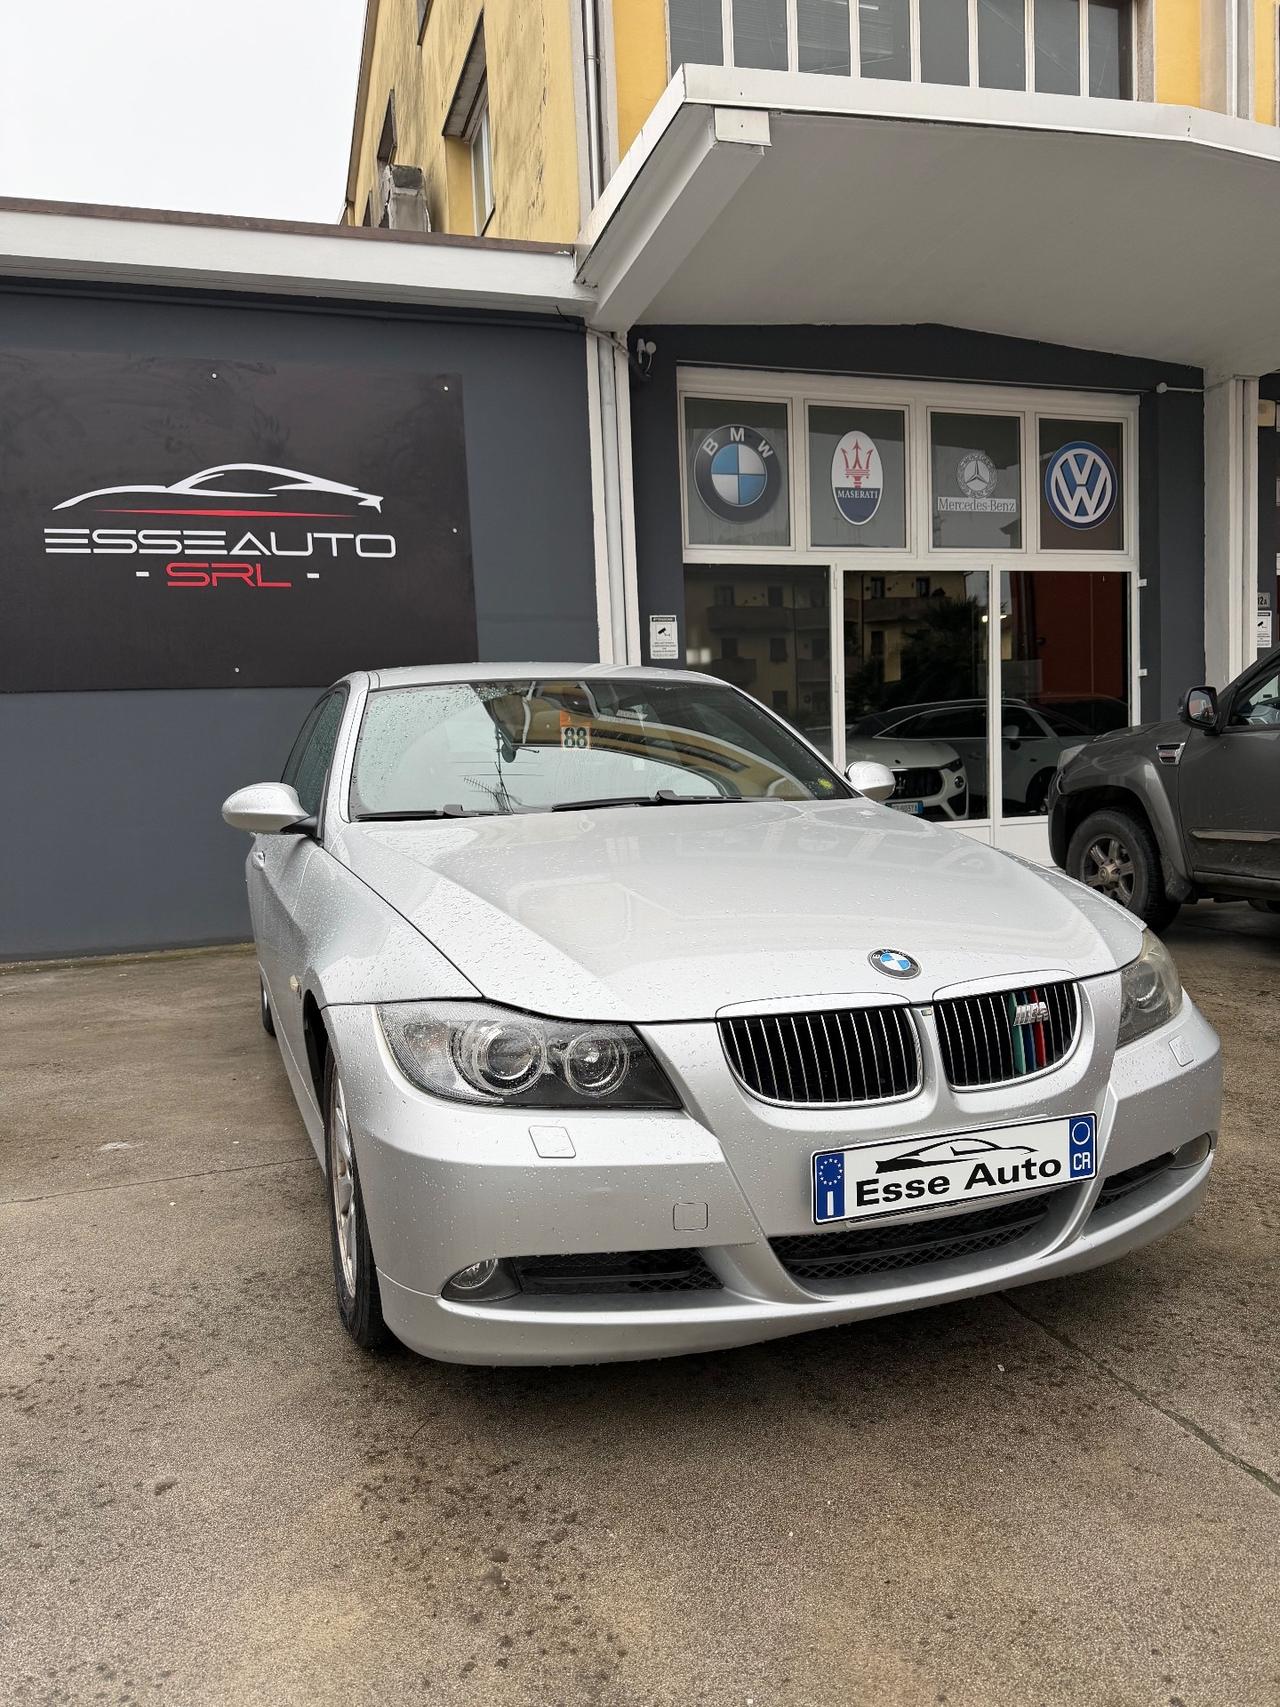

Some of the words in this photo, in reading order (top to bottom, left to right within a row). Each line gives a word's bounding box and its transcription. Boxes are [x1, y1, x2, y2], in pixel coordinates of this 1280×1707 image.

[702, 427, 774, 459] BMW
[837, 489, 879, 500] MASERATI
[938, 498, 1016, 512] Mercedes-Benz
[44, 528, 396, 558] ESSEAUTO
[166, 562, 292, 587] SRL
[564, 727, 587, 748] 88
[856, 1175, 950, 1207] Esse
[964, 1157, 1062, 1190] Auto
